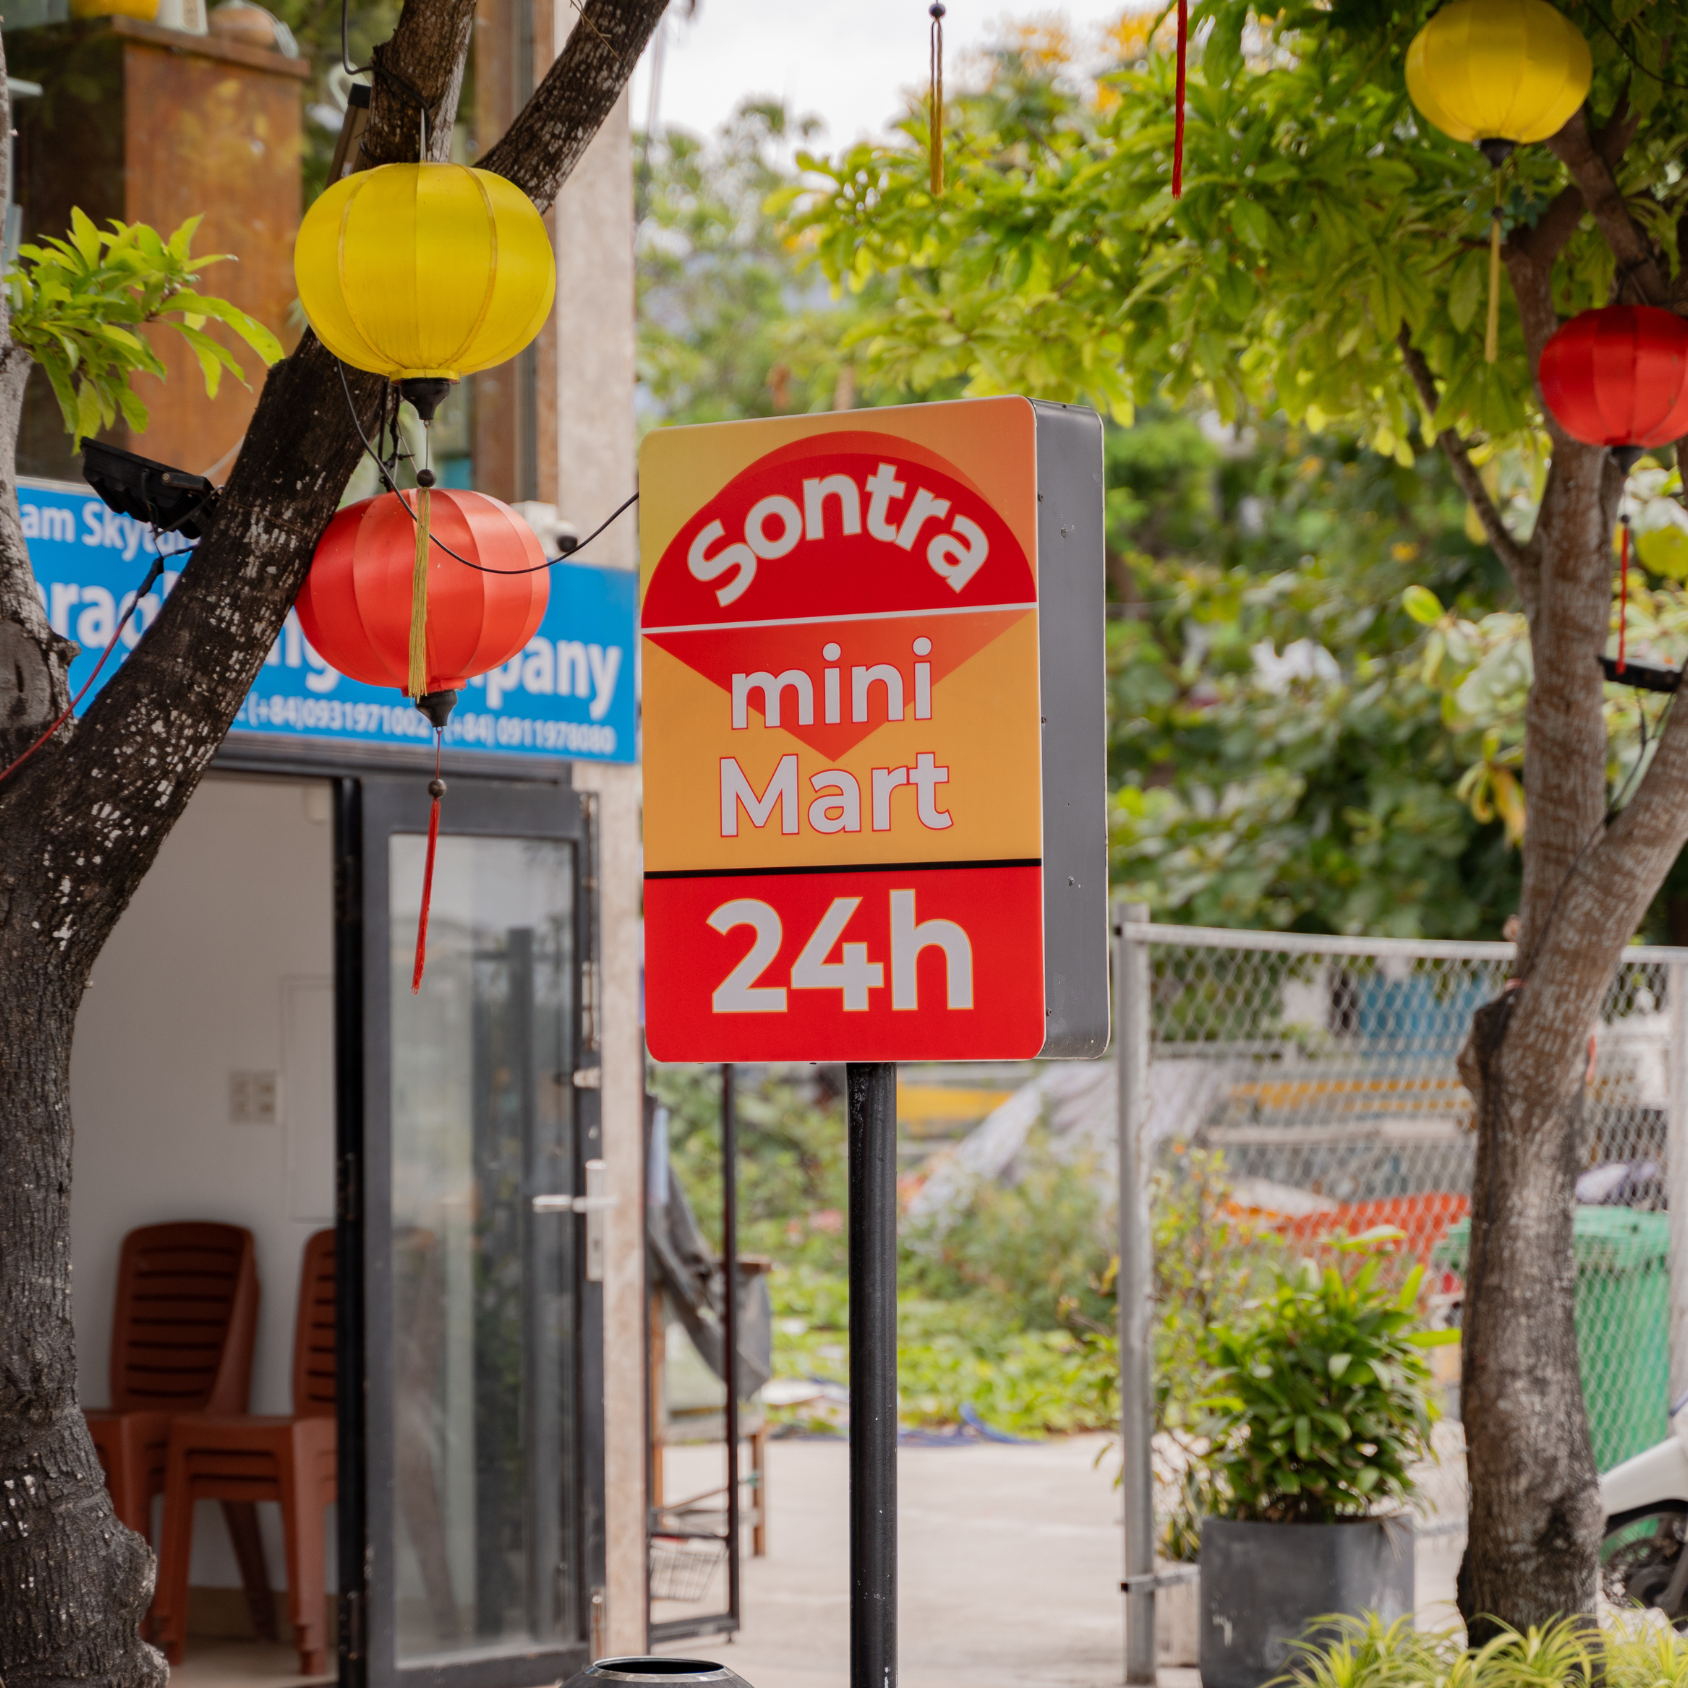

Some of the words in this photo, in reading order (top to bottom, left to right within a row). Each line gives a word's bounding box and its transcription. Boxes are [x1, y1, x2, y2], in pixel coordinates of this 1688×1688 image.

[687, 463, 989, 607] Sontra
[731, 637, 933, 730] mini
[719, 752, 954, 838] Mart
[705, 888, 975, 1014] 24h
